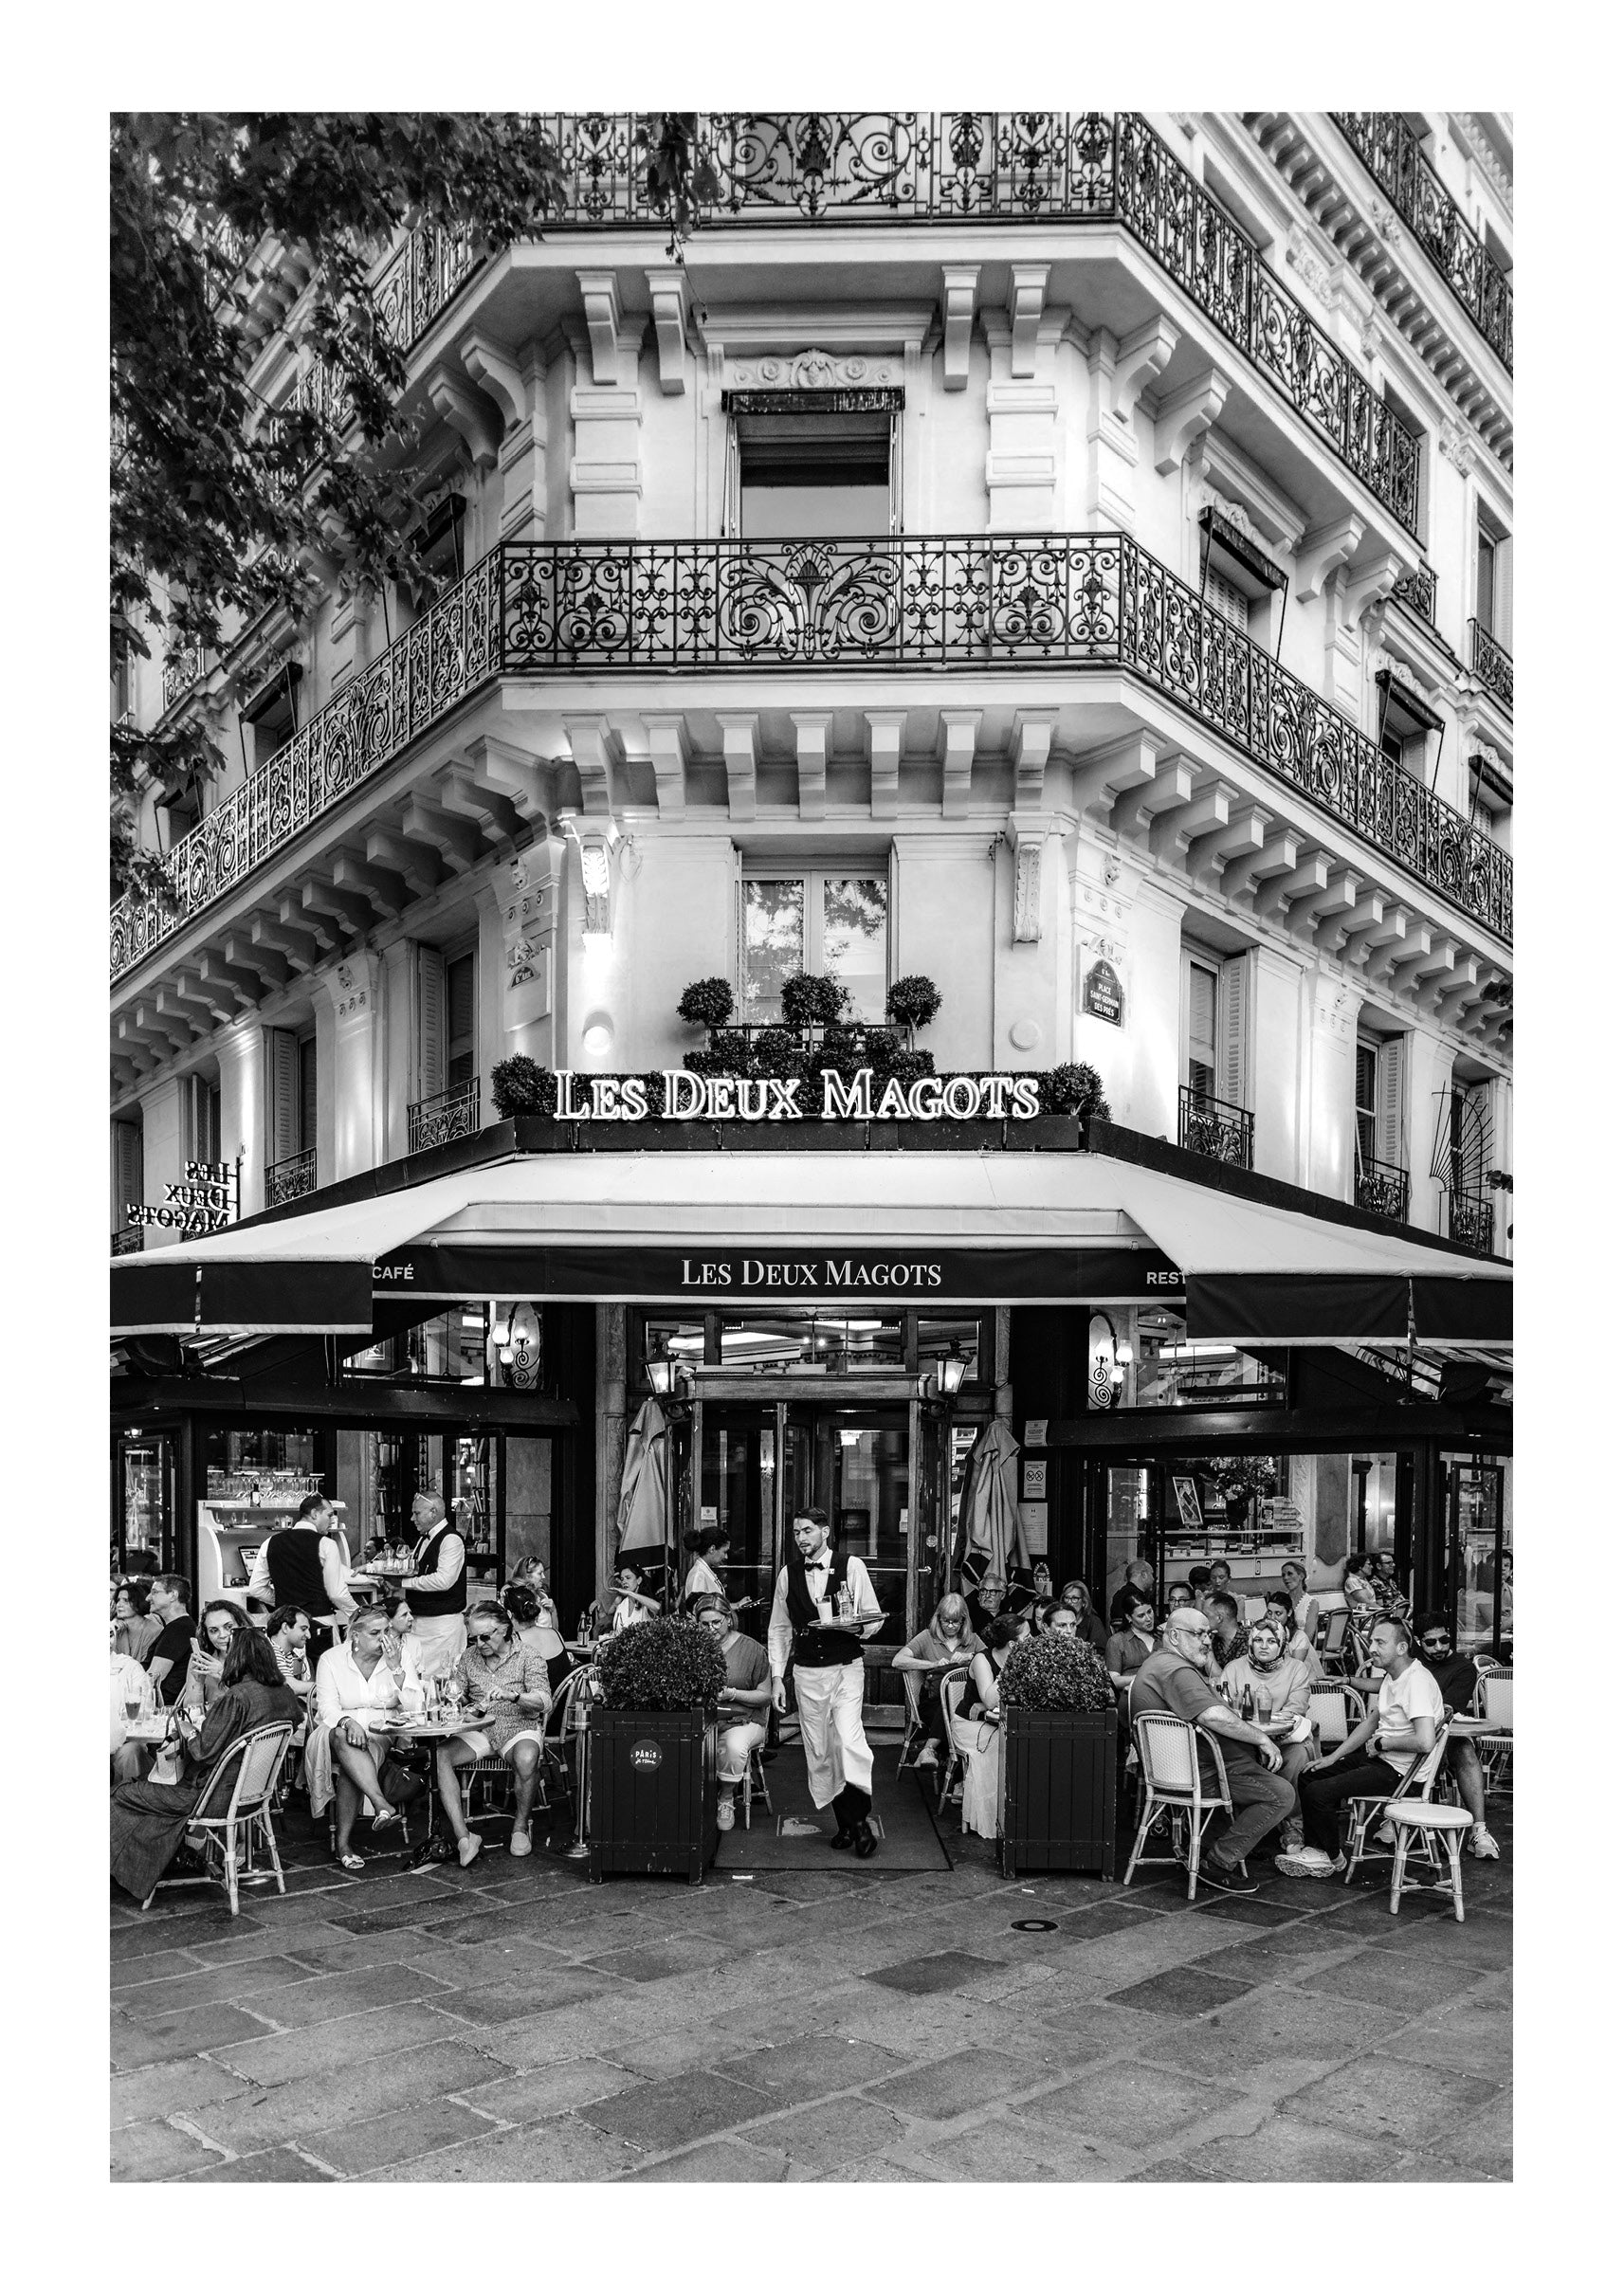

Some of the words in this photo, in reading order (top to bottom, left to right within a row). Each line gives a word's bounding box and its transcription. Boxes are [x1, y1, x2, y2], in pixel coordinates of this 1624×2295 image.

[1098, 983, 1111, 995] PLACE
[1094, 1002, 1103, 1012] DES
[554, 1069, 648, 1120] LES
[662, 1069, 803, 1120] DEUX
[820, 1068, 1040, 1120] MAGOTS
[372, 1263, 414, 1280] CAFÉ
[681, 1259, 732, 1285] LES
[740, 1260, 818, 1286] DEUX
[824, 1260, 942, 1286] MAGOTS
